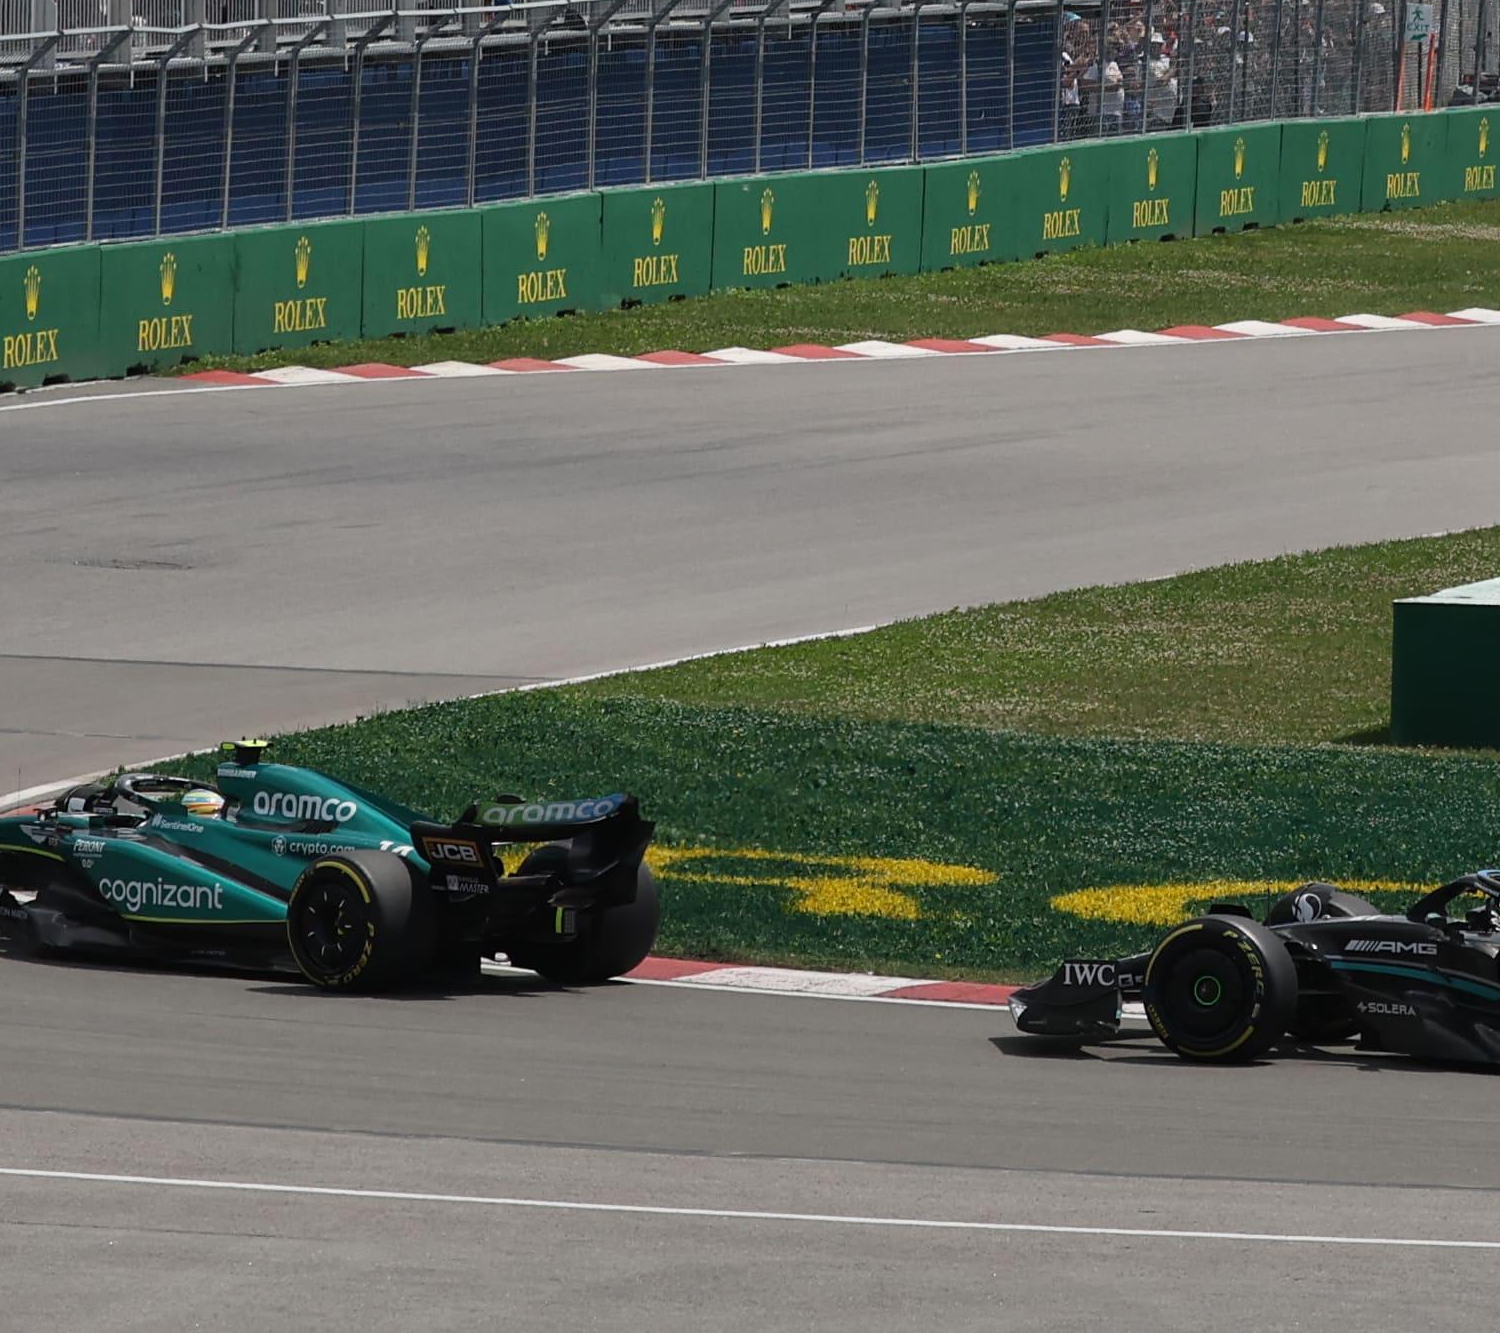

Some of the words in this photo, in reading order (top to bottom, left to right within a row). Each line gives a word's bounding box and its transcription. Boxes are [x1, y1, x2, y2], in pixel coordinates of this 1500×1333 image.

[1407, 23, 1431, 31] EXIT
[1387, 172, 1419, 198] ROLEX
[1464, 165, 1495, 191] ROLEX
[1220, 187, 1253, 216] ROLEX
[1300, 180, 1336, 206] ROLEX
[1044, 209, 1080, 238] ROLEX
[1133, 198, 1170, 227] ROLEX
[848, 235, 891, 264] ROLEX
[951, 224, 990, 254] ROLEX
[633, 255, 678, 286] ROLEX
[743, 245, 786, 274] ROLEX
[518, 269, 568, 303] ROLEX
[275, 298, 326, 331] ROLEX
[397, 285, 446, 319] ROLEX
[138, 314, 192, 351] ROLEX
[4, 329, 58, 368] ROLEX
[253, 791, 357, 823] aramco
[483, 800, 614, 823] aramco
[431, 845, 477, 862] JCB
[99, 877, 224, 912] cognizant
[1375, 940, 1438, 955] AMG
[1063, 963, 1116, 987] IWC
[1367, 1002, 1417, 1017] SOLERA
